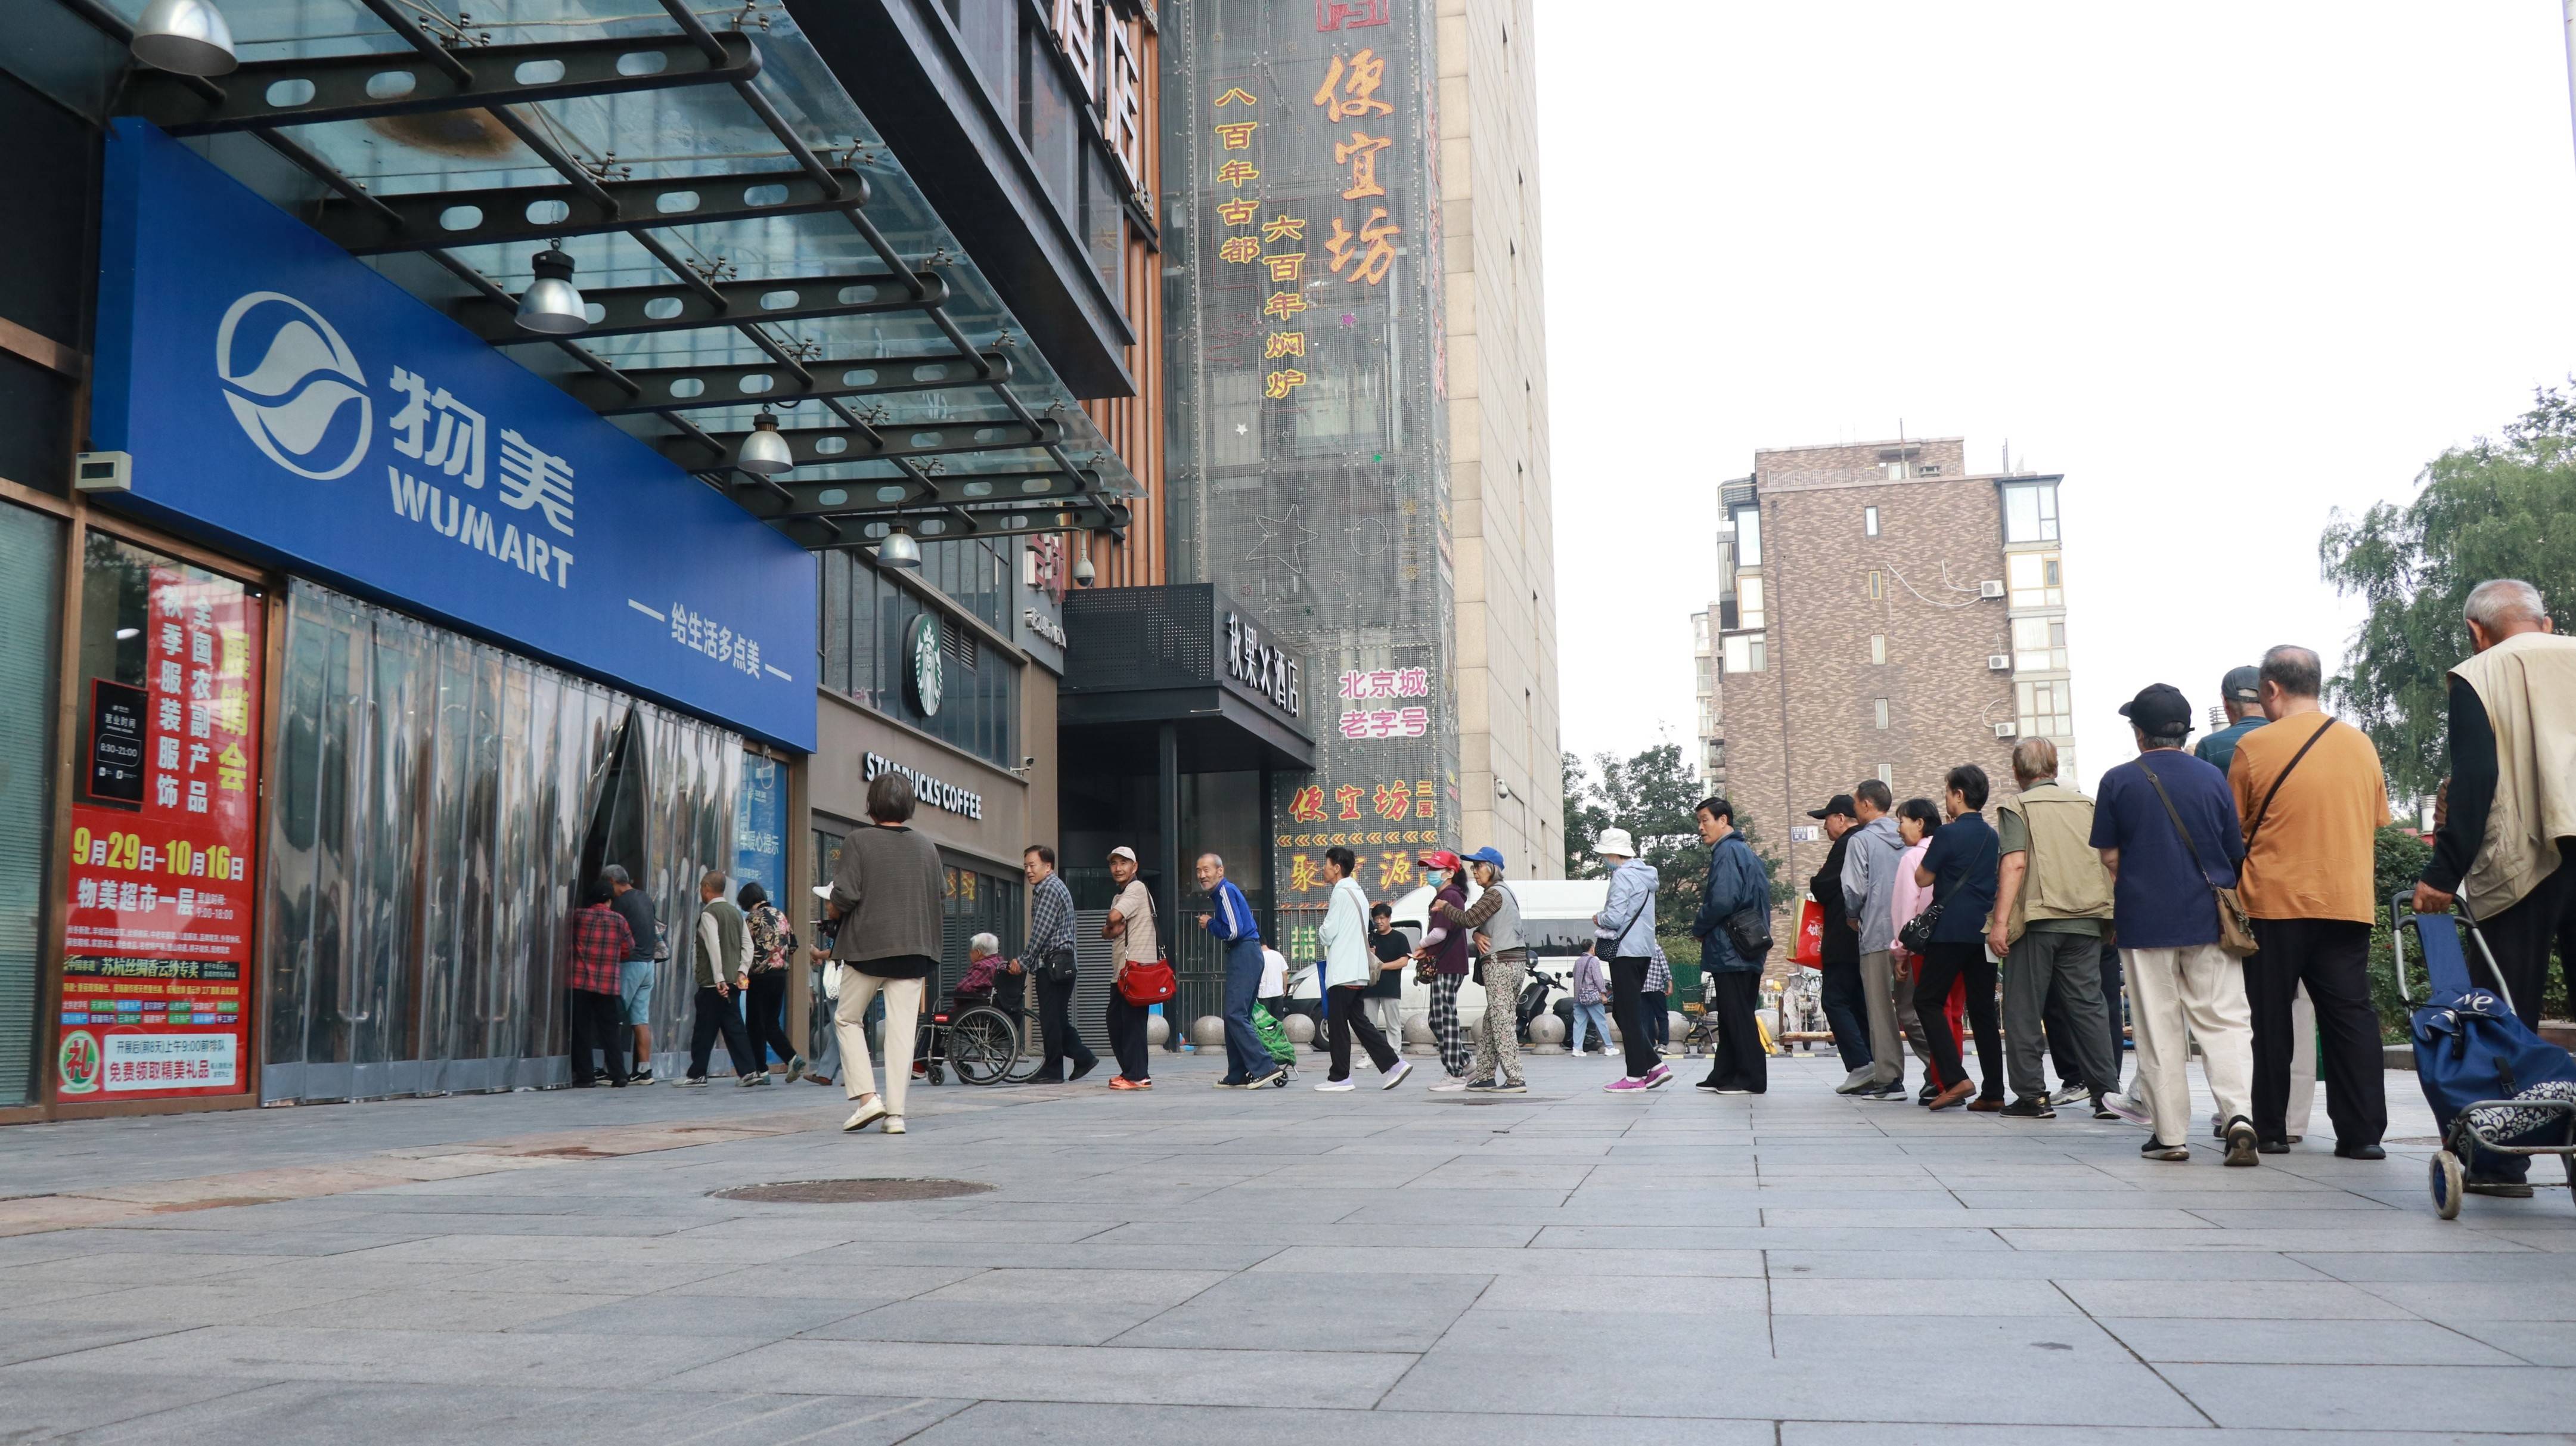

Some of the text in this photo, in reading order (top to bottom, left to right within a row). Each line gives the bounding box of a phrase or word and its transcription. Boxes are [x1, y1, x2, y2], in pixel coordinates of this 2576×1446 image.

[1214, 88, 1260, 264] 八百年古都
[1314, 48, 1401, 286] 便宜坊
[1262, 215, 1306, 399] 六百年焖炉
[389, 365, 575, 537] 物美
[387, 465, 574, 589] WUMART
[671, 601, 761, 681] 给生活多点美
[187, 597, 213, 813] 全国农副产品
[1339, 667, 1429, 702] 北京城
[1339, 706, 1430, 740] 老字号
[942, 783, 982, 820] COFFEE
[1289, 780, 1411, 823] 便宜坊
[1416, 781, 1434, 818] 三层
[73, 827, 244, 882] 9月29日-10月16日
[77, 877, 195, 917] 物美超市一层
[101, 957, 199, 979] 苏杭丝绸香云纱专卖
[66, 1039, 94, 1081] 礼
[110, 1059, 209, 1082] 免费领取精美礼品
